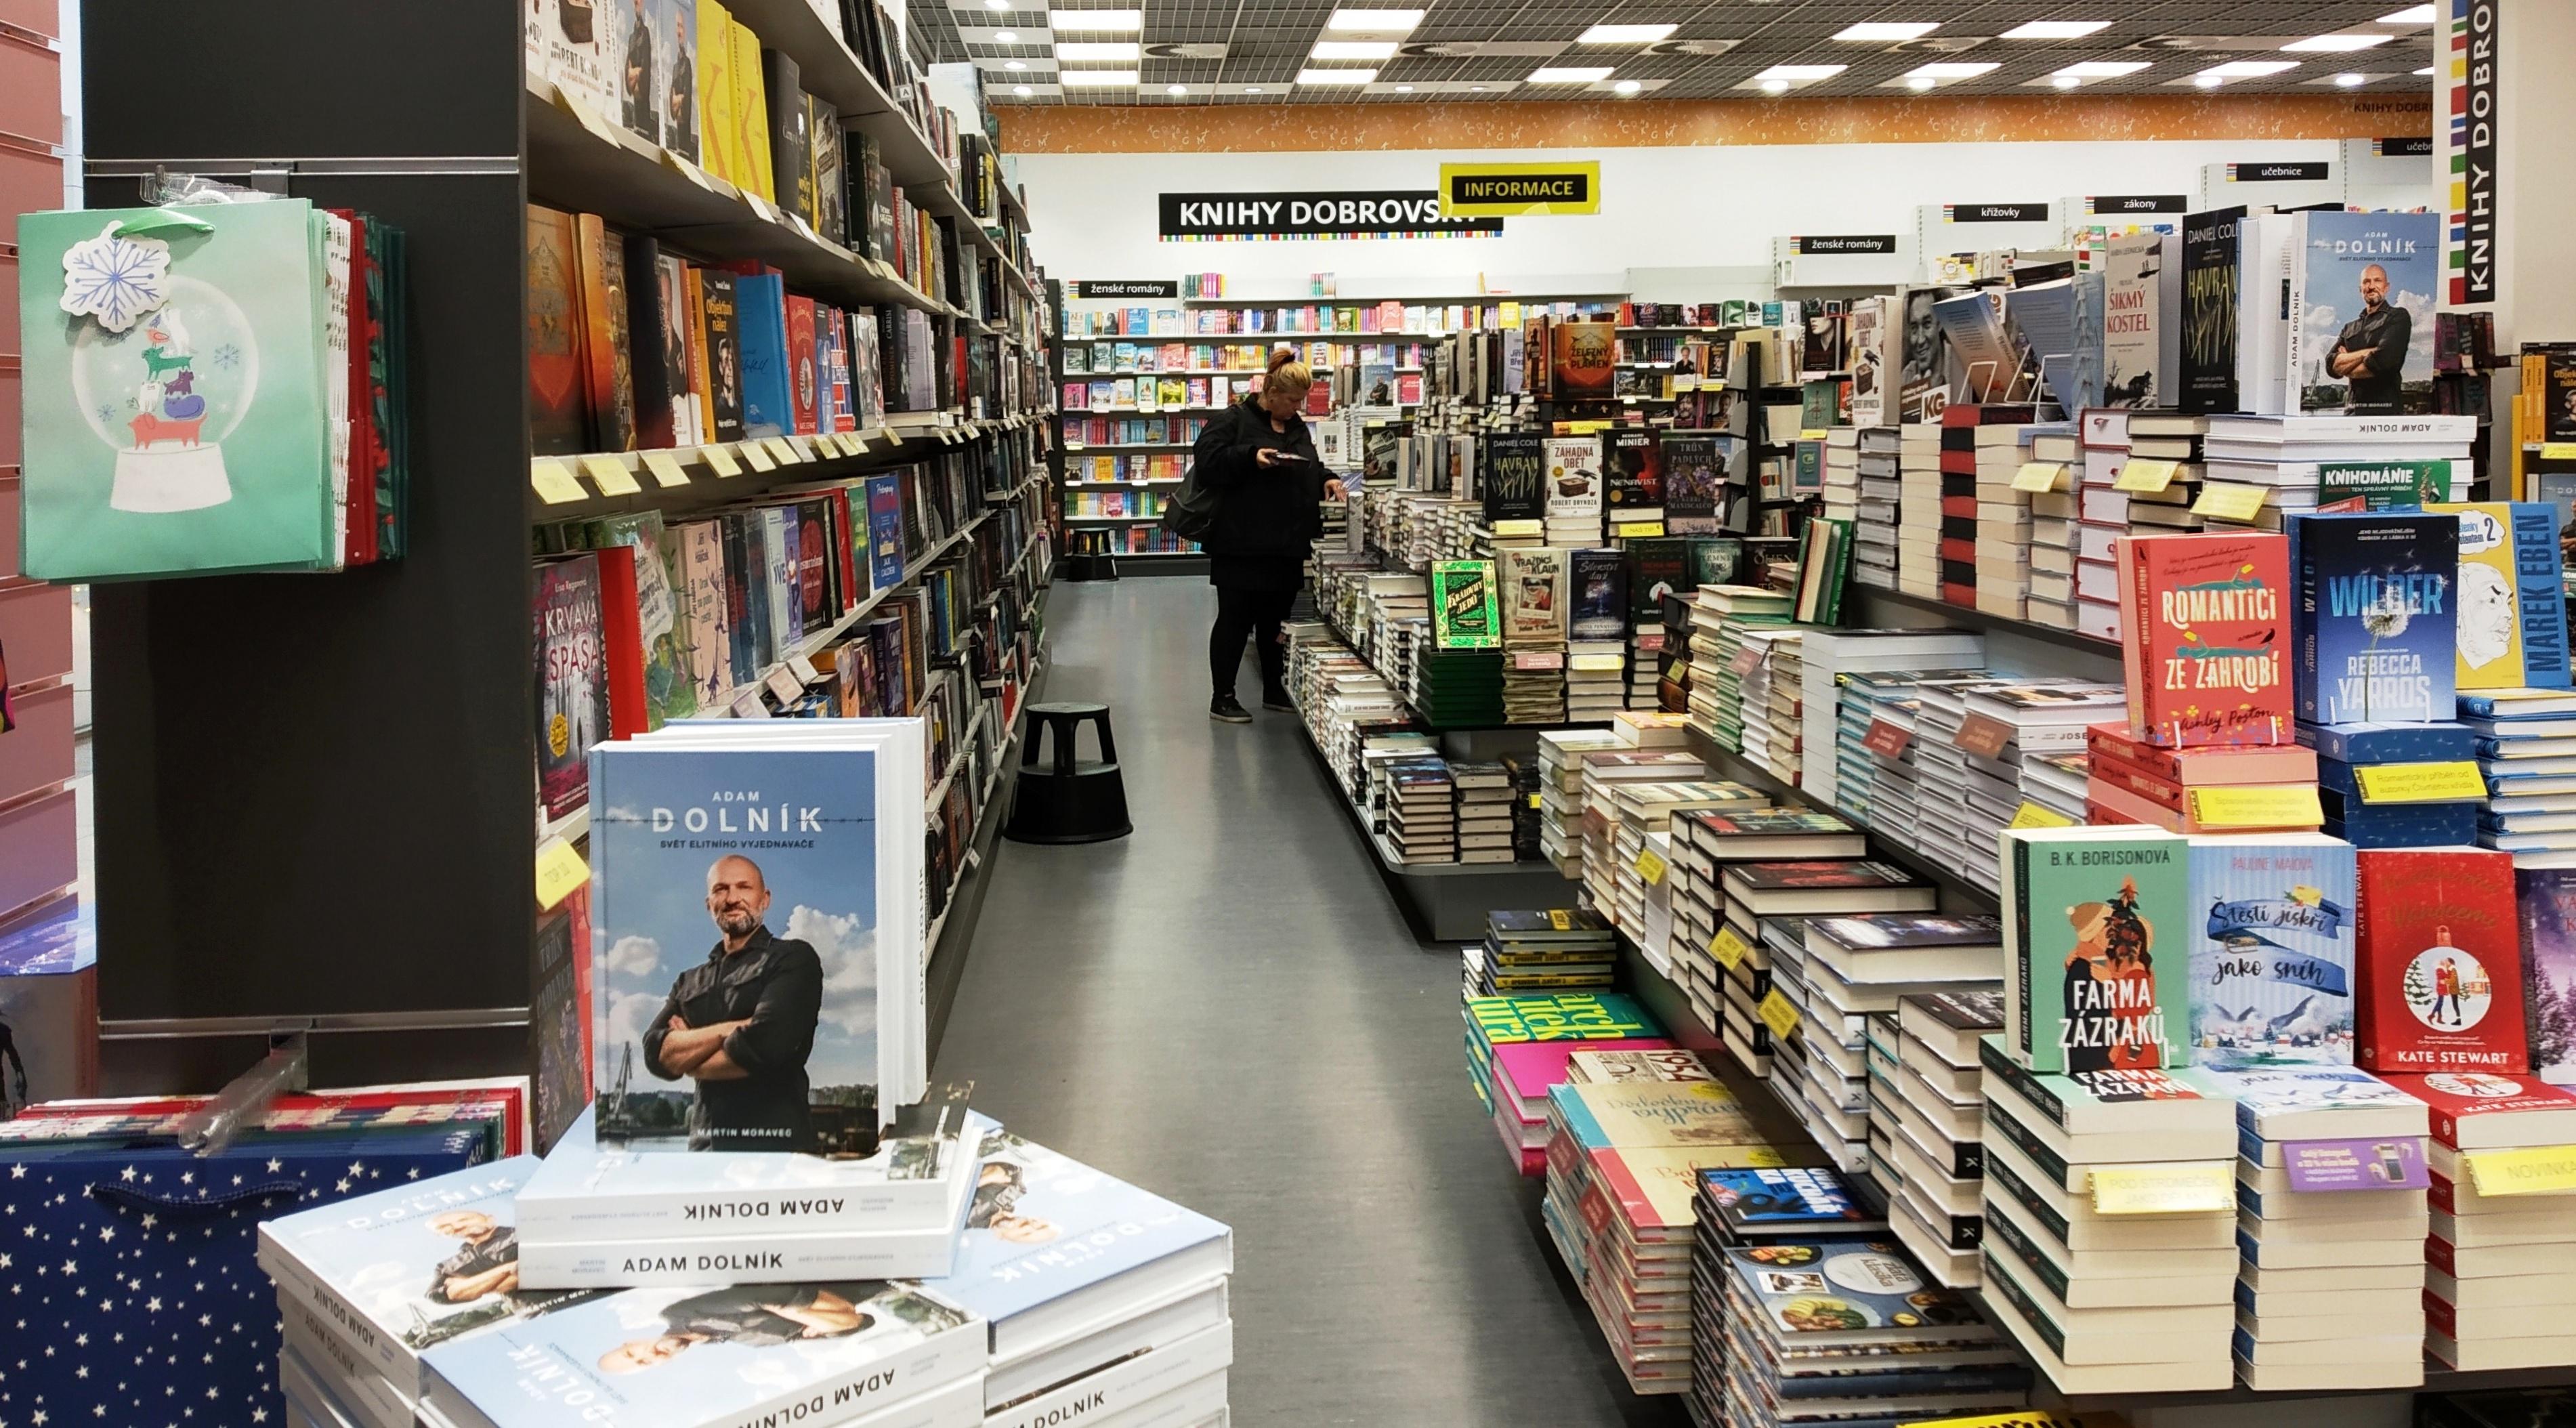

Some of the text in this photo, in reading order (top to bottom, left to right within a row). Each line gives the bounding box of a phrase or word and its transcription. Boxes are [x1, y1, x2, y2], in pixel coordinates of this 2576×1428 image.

[2354, 102, 2392, 113] KNIHY
[2470, 0, 2491, 292] KNIHY DOBRO
[2261, 166, 2302, 177] učebnice
[1464, 180, 1574, 197] INFORMACE
[1180, 199, 1477, 226] KNIHY DOBROVS
[1981, 206, 2020, 219] křížovky
[2124, 198, 2157, 211] zákony
[1811, 238, 1883, 251] ženské romány
[2189, 229, 2216, 245] DANIEL
[2336, 238, 2416, 253] DOLNÍK
[1091, 285, 1164, 295] ženské romány
[2109, 285, 2147, 310] ŠIKMÝ
[2107, 313, 2151, 333] KOSTEL
[1924, 392, 1945, 416] KG
[2359, 425, 2398, 433] DOLNÍK
[1616, 438, 1650, 447] MINIER
[1494, 457, 1539, 471] HAVRAN
[2325, 467, 2413, 485] KNIHOMÁNIE
[2485, 518, 2496, 541] 2
[2329, 572, 2443, 617] WILDER
[2516, 515, 2562, 672] MAREK EBEN
[545, 590, 598, 637] KRVAVÁ
[2162, 586, 2277, 630] ROMANTICI
[2165, 650, 2279, 694] ZE ZÁHROBÍ
[2348, 654, 2422, 676] REBECCA
[2338, 676, 2430, 711] YARROS
[2180, 713, 2224, 734] Ashley
[712, 791, 759, 802] ADAM
[652, 803, 823, 833] DOLNÍK
[660, 838, 815, 849] SVĚT ELITNÍHO VYJEDNAVAČE
[2051, 846, 2170, 866] B. K. BORISONOVÁ
[2210, 896, 2327, 933] Štěstí jiskří
[2358, 915, 2366, 938] KATE
[2212, 955, 2325, 986] jako sníh
[2073, 978, 2152, 1011] FARMA
[1553, 994, 1645, 1038] arch
[2058, 1006, 2166, 1049] ZÁZRAKŮ
[1647, 1051, 1710, 1083] 1954
[2398, 1051, 2509, 1065] KATE STEWART
[2075, 1068, 2170, 1085] FARMA
[2464, 1098, 2574, 1114] KATE STEWART
[697, 1128, 793, 1137] MARTIN MORAVEC
[683, 1202, 769, 1222] DOLNÍK
[780, 1198, 845, 1216] ADAM
[622, 1251, 784, 1274] ADAM DOLNÍK
[313, 1285, 375, 1348] ADAM DOLNÍK
[305, 1314, 325, 1343] ADAM
[835, 1368, 895, 1406] ADAM
[1034, 1390, 1105, 1428] DOLNÍK
